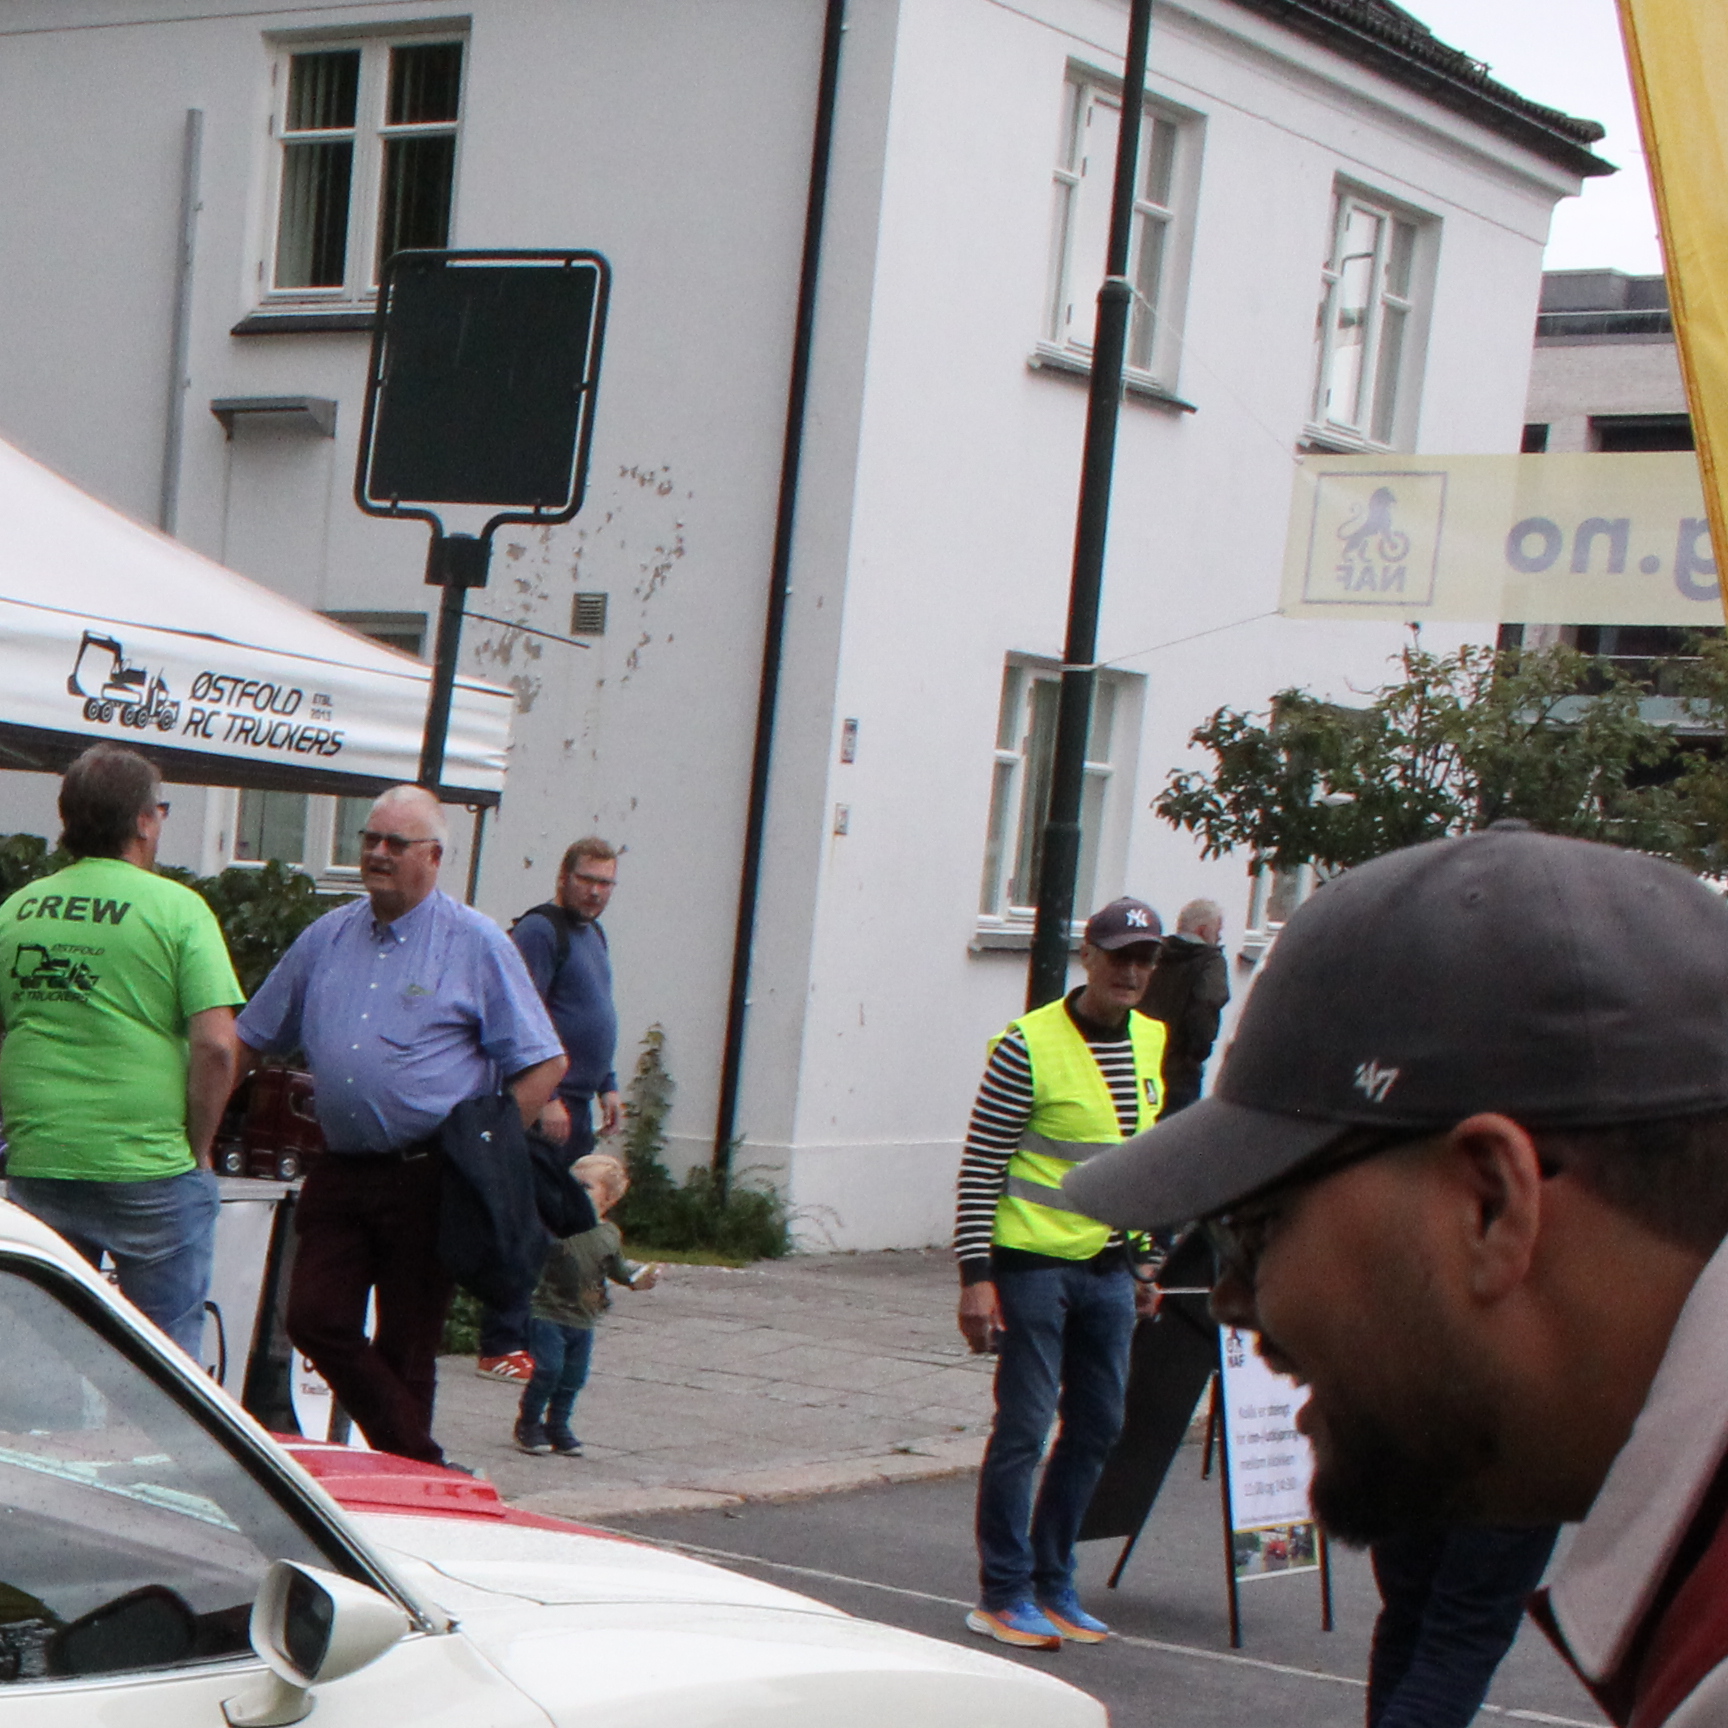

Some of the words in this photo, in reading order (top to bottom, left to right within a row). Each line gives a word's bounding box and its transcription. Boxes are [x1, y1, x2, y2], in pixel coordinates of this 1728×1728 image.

[189, 670, 304, 716] ØSTFOLD
[182, 707, 220, 740] RC
[222, 713, 345, 757] TRUCKERS
[16, 895, 132, 925] CREW
